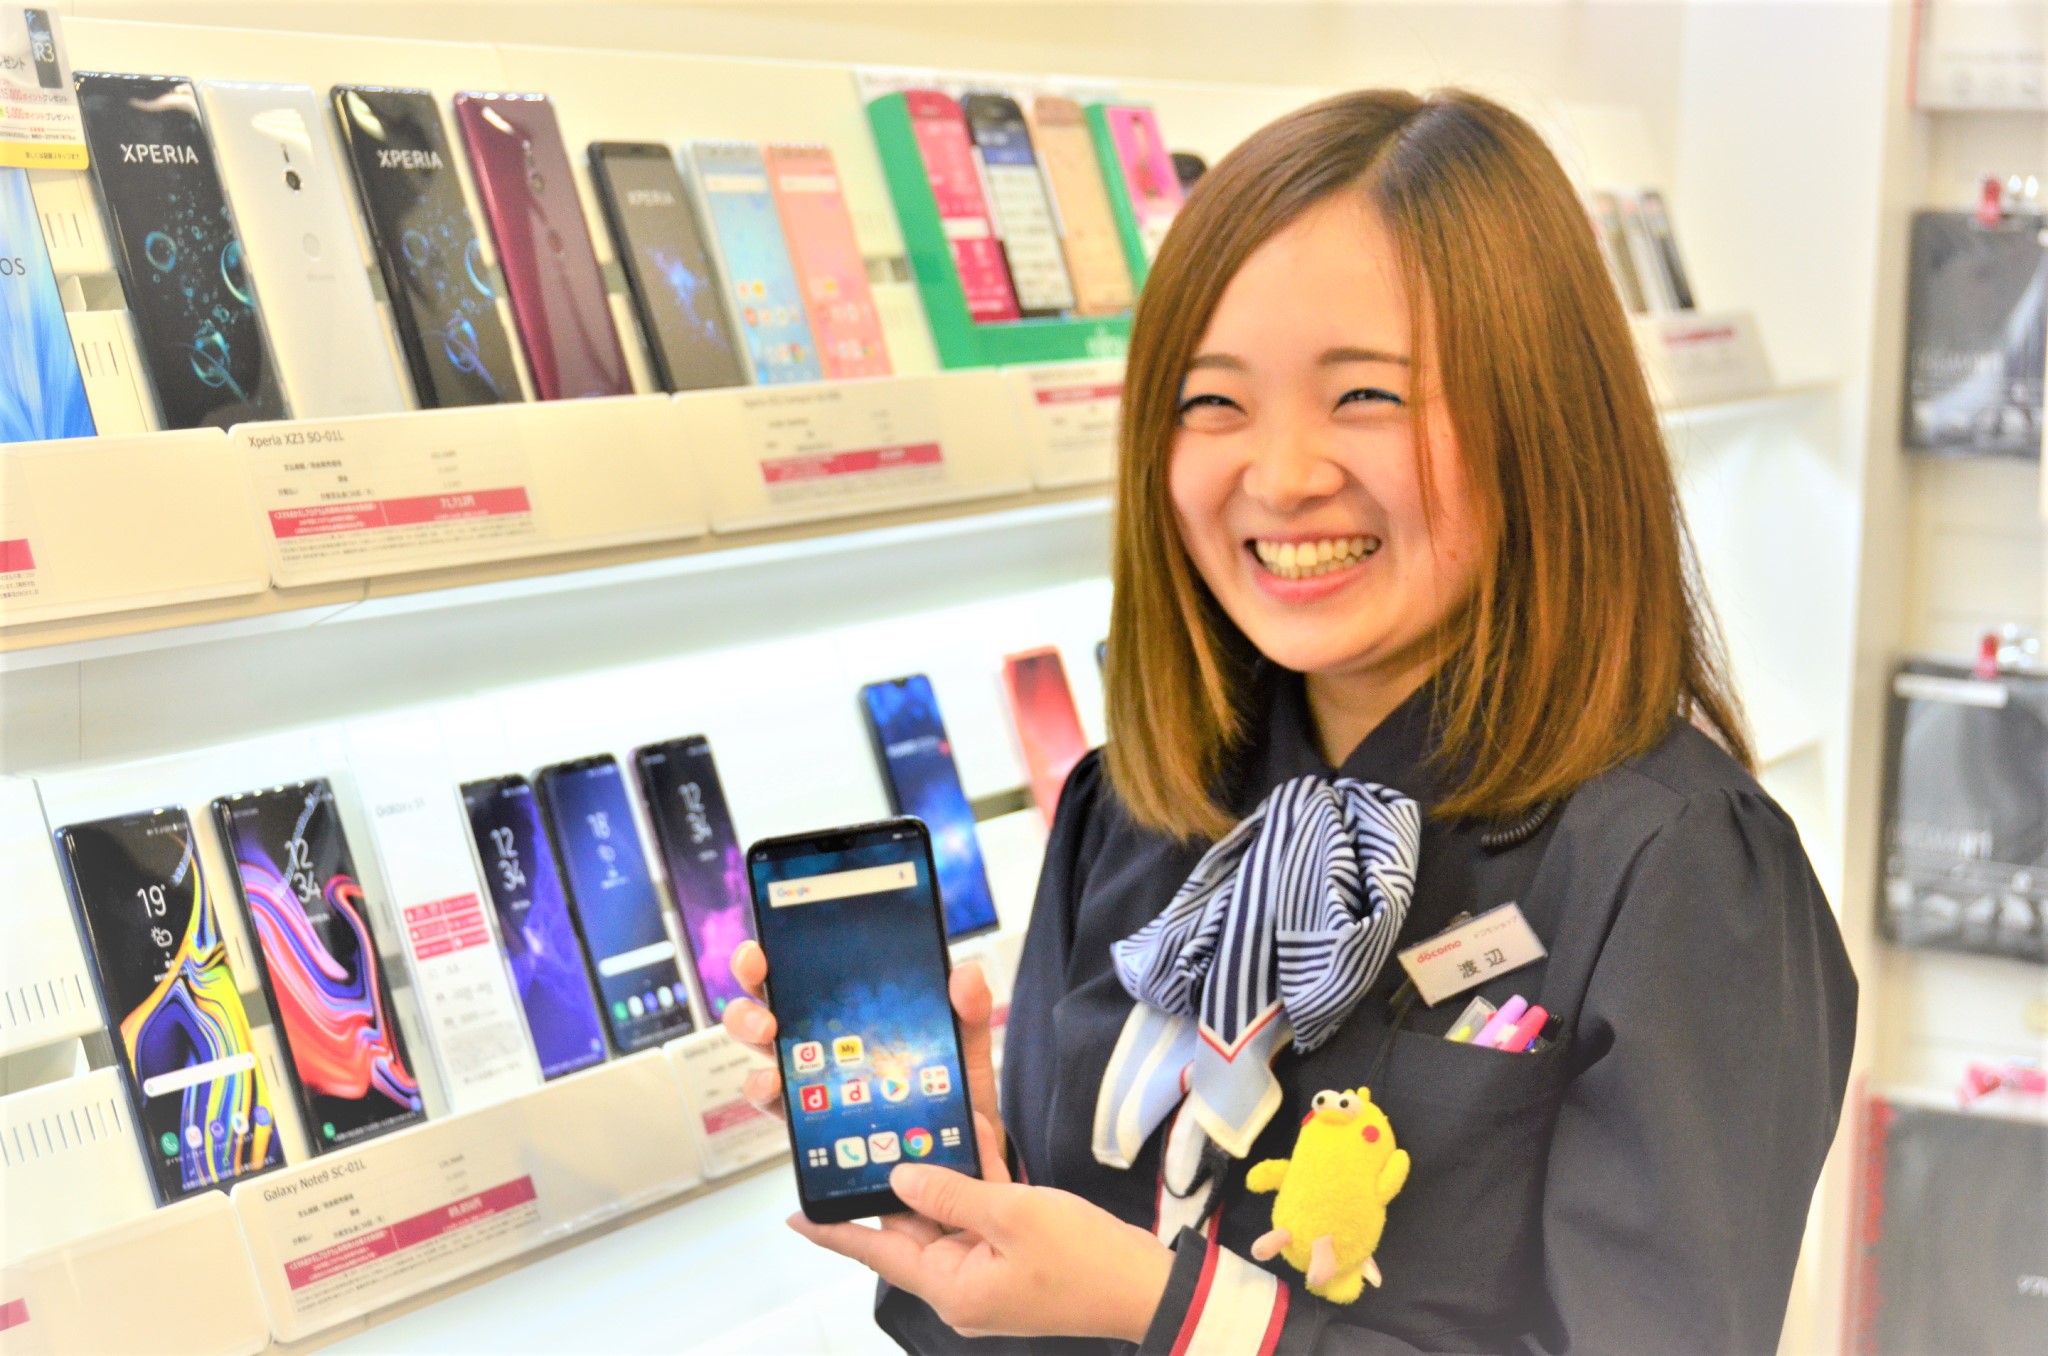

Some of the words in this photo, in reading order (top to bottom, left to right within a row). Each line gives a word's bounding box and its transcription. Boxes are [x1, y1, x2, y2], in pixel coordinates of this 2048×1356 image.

[0, 55, 26, 71] ゼント
[34, 42, 55, 63] R3
[120, 143, 199, 165] XPERIA
[376, 149, 444, 169] XPERIA
[0, 257, 26, 276] OS
[248, 434, 282, 450] Xperia
[284, 431, 305, 445] XZ3
[307, 429, 344, 444] SO-01L
[490, 826, 518, 858] 12
[498, 858, 526, 891] 34
[294, 871, 321, 904] 34
[1417, 940, 1462, 963] docomo
[264, 1183, 298, 1202] Galaxy
[300, 1170, 329, 1189] Note9
[331, 1159, 367, 1178] SC-01L
